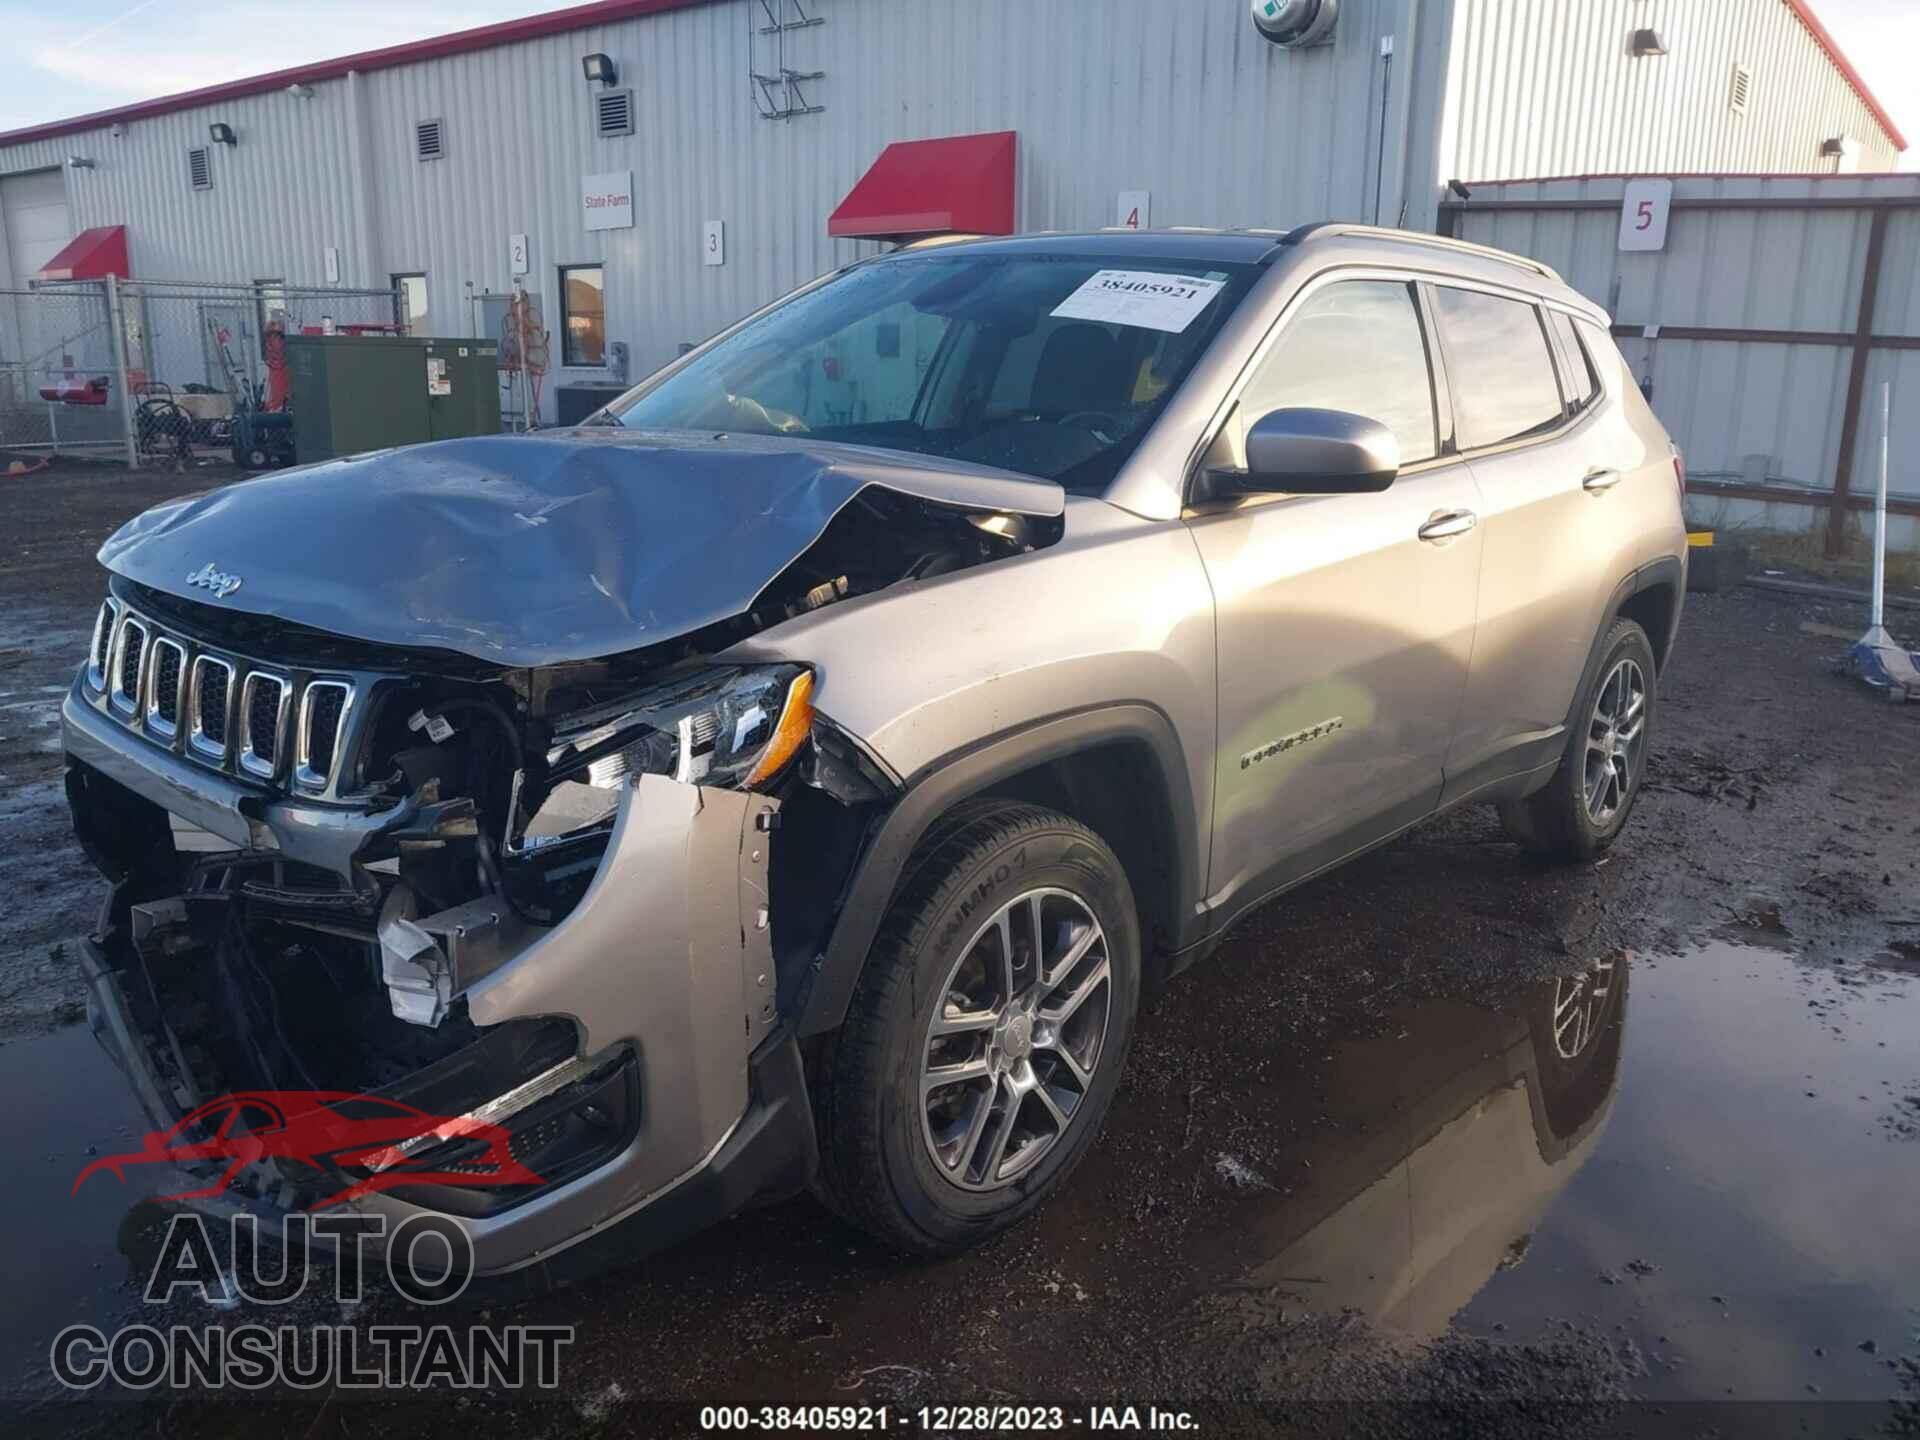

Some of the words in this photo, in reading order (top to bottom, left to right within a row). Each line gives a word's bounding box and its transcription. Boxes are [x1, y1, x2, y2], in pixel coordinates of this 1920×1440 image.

[585, 195, 606, 209] State
[607, 193, 630, 207] Farm
[1126, 207, 1139, 230] 4
[1635, 201, 1653, 231] 5
[710, 233, 717, 252] 3
[514, 245, 522, 263] 2
[1094, 278, 1198, 300] 38405921
[185, 562, 242, 599] Jeep
